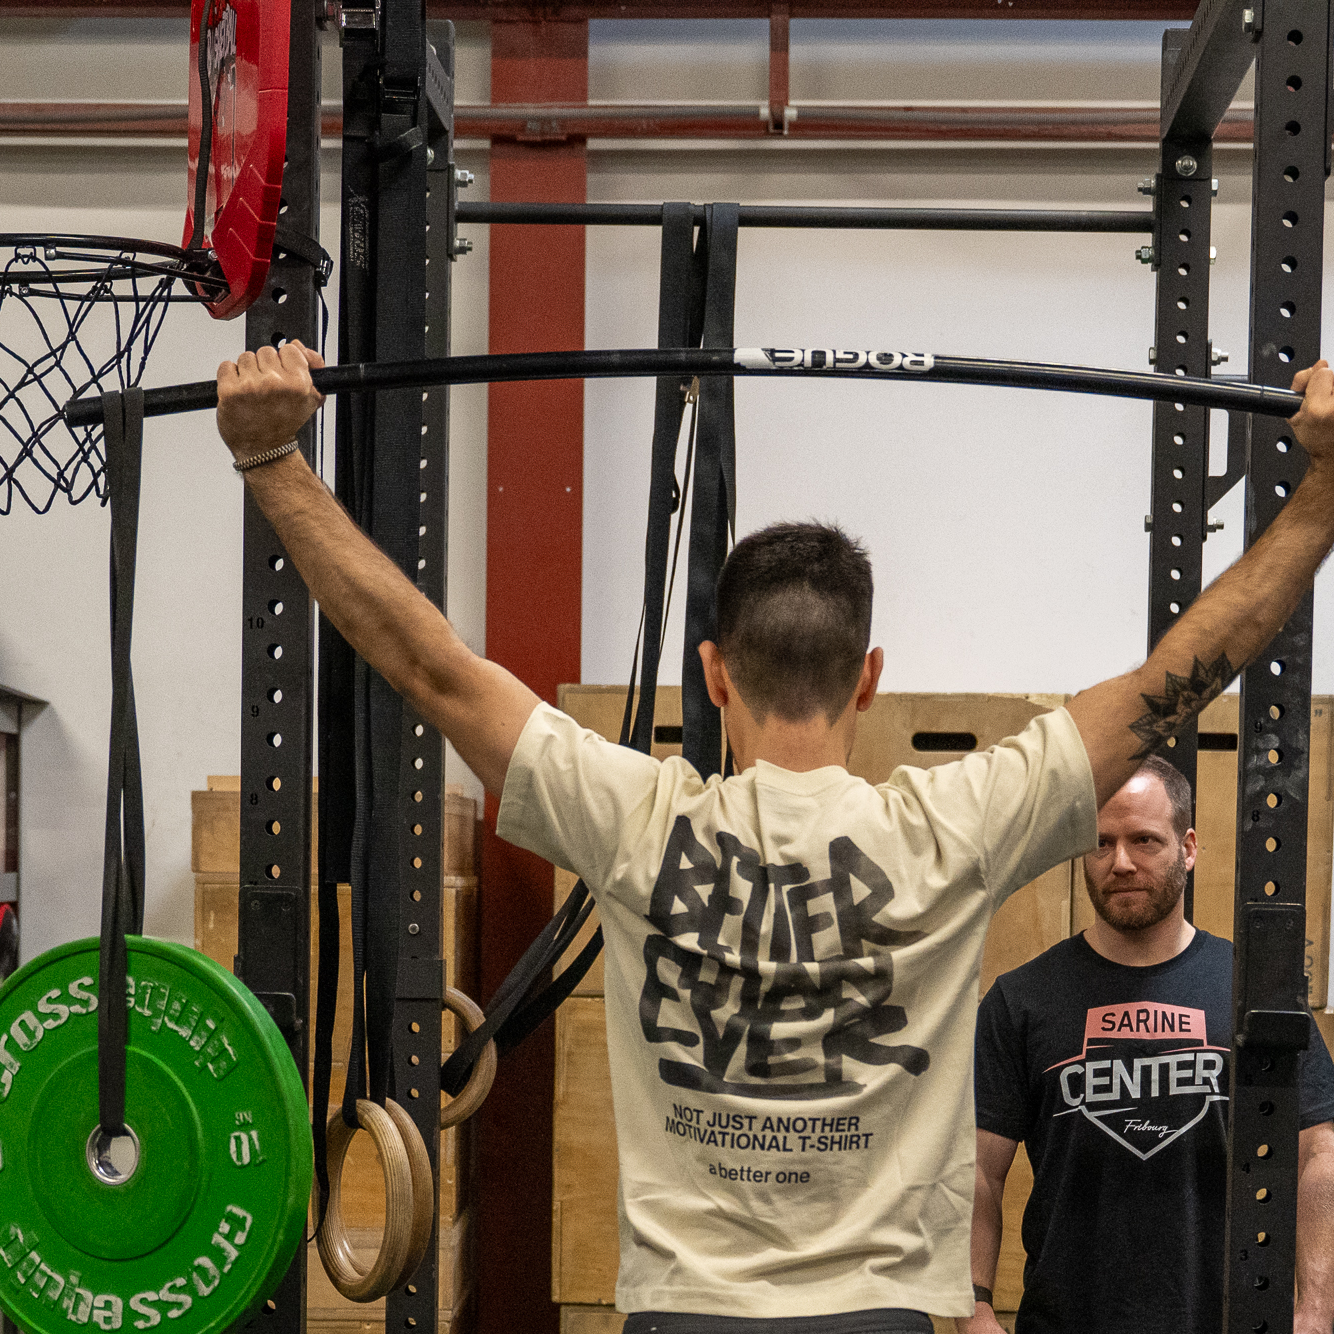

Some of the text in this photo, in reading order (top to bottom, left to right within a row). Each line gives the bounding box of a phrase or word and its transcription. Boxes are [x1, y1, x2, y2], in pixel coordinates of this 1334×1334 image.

[772, 348, 935, 371] ROGUE
[247, 616, 265, 630] 10
[250, 705, 260, 718] 9
[1251, 809, 1260, 822] 8
[646, 814, 930, 963] BETTER
[638, 933, 931, 1084] EVER
[1100, 1008, 1192, 1033] SARINE
[1059, 1052, 1224, 1107] CENTER
[672, 1102, 861, 1133] NOT JUST ANOTHER
[1123, 1118, 1179, 1137] Fribourg
[665, 1115, 874, 1152] MOTIVATIONAL T-SHIRT
[774, 1169, 812, 1184] one
[127, 1204, 255, 1331] cross
